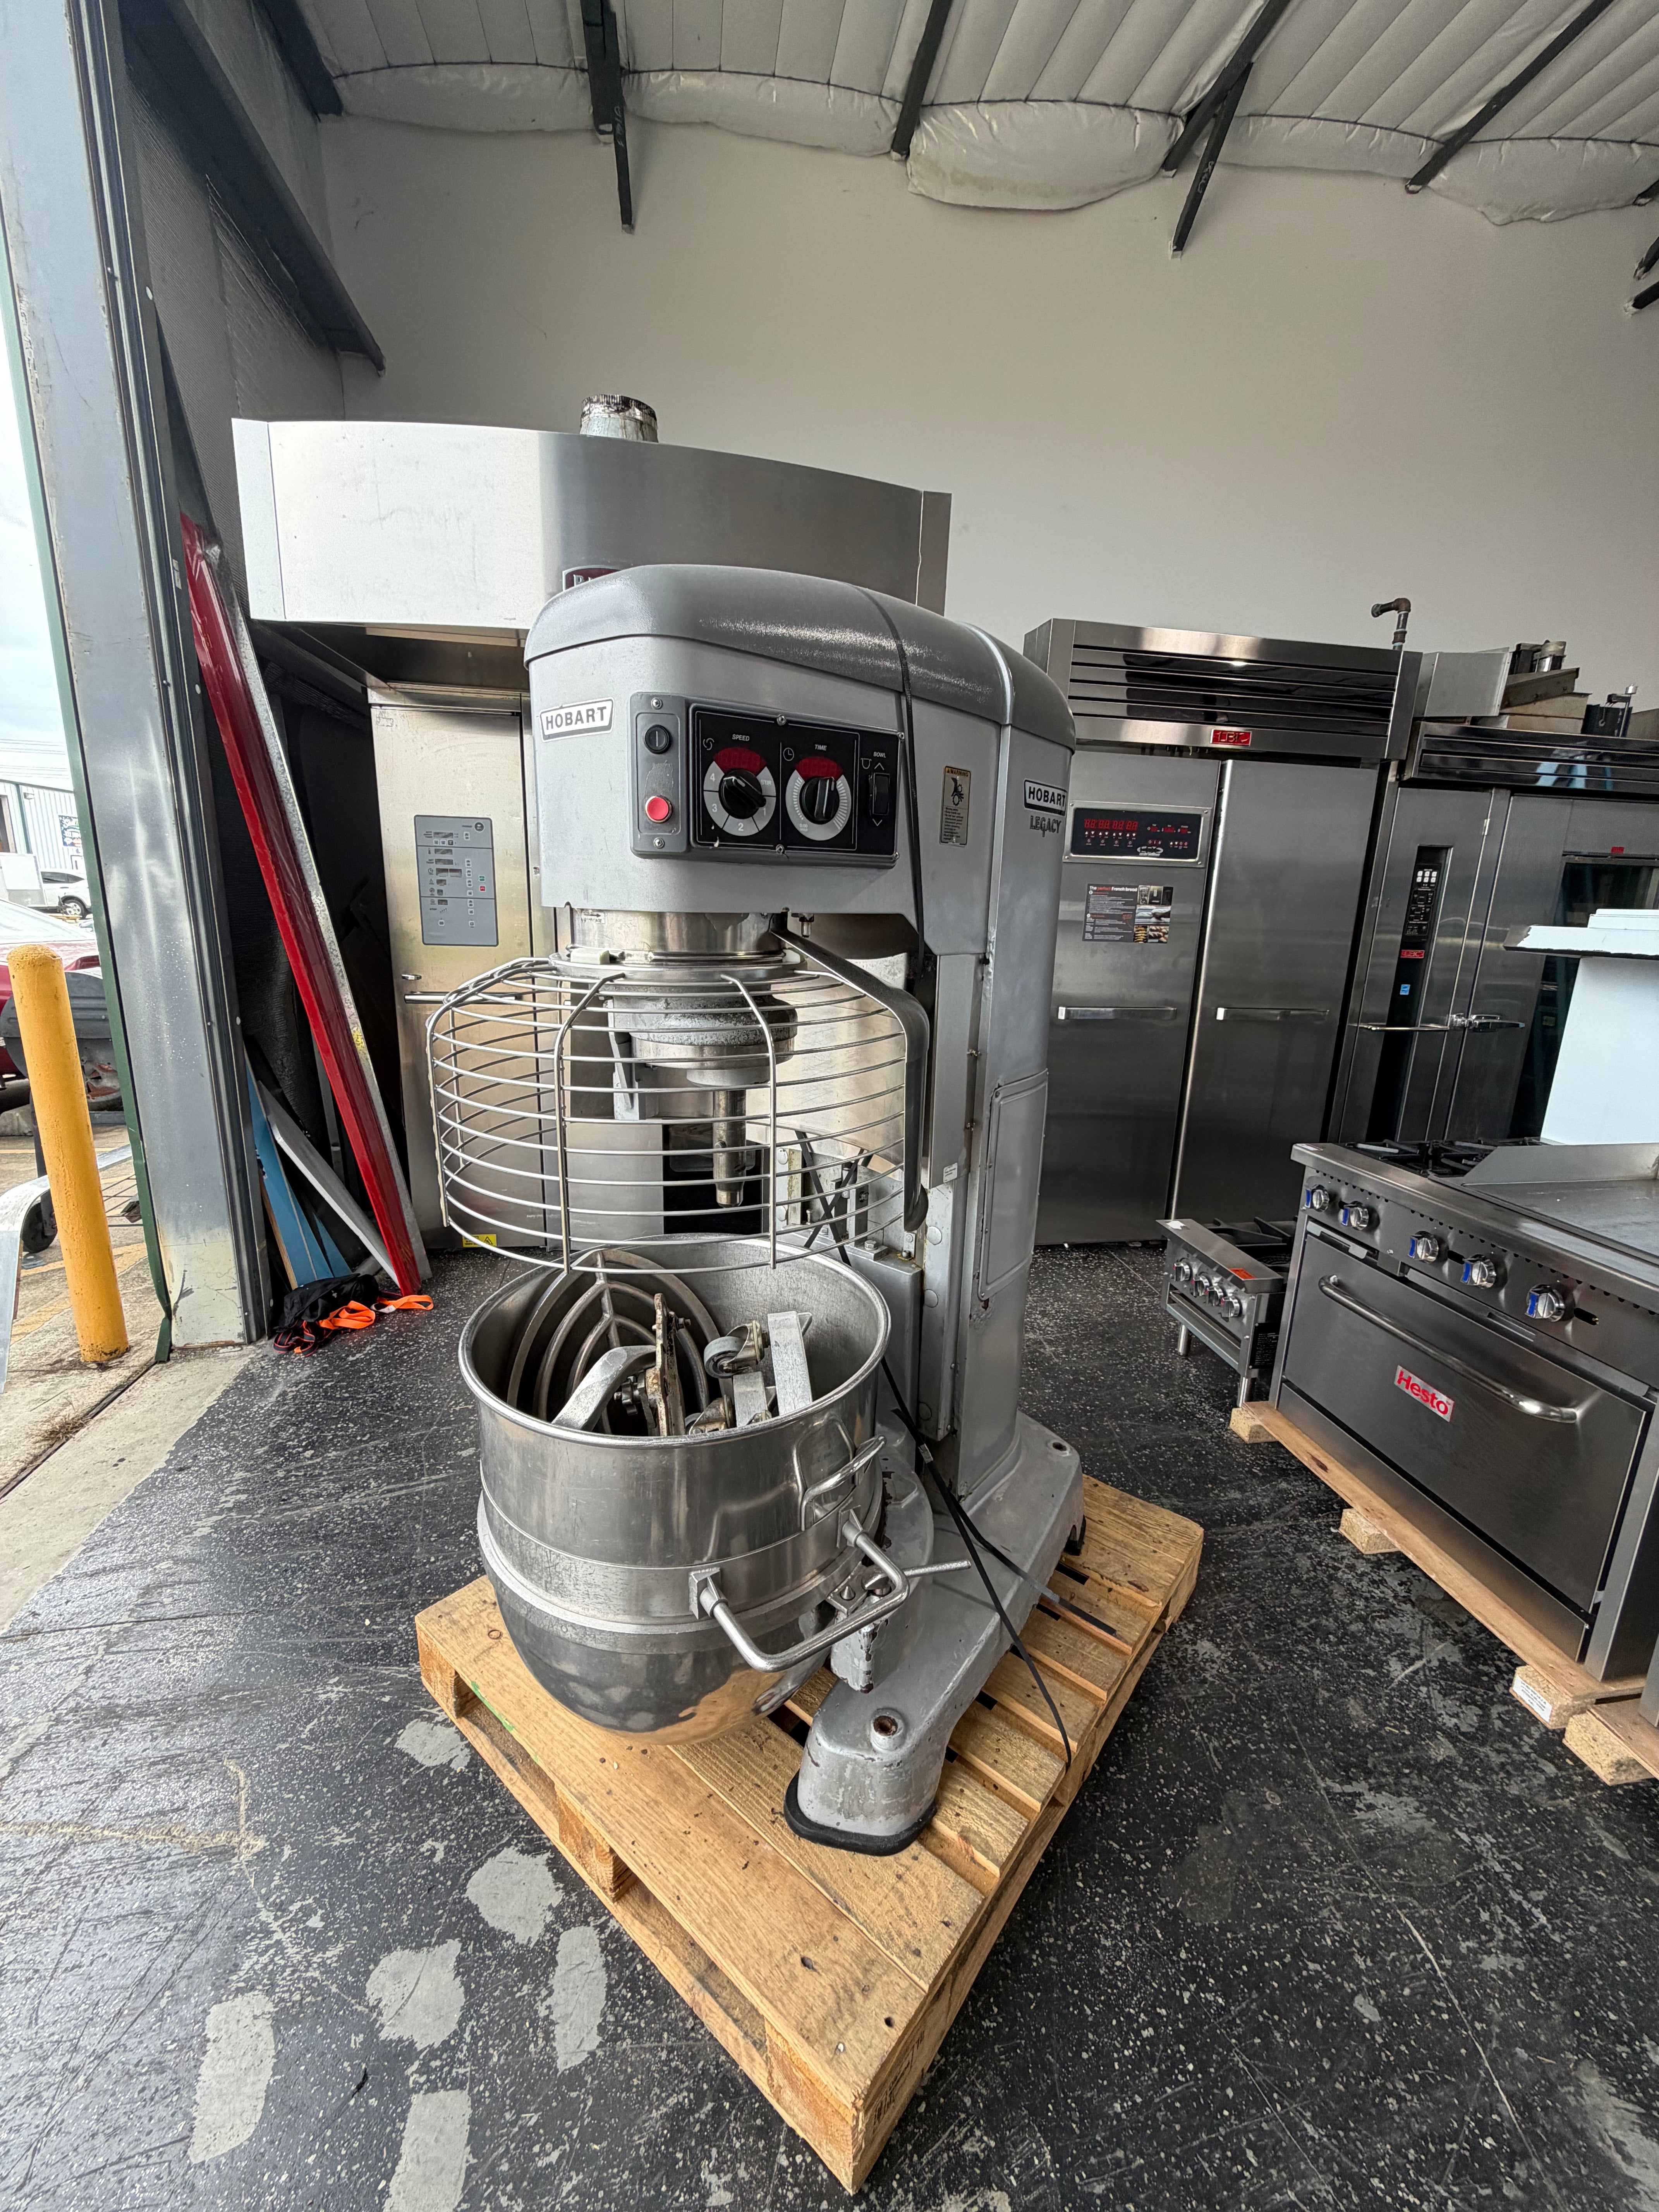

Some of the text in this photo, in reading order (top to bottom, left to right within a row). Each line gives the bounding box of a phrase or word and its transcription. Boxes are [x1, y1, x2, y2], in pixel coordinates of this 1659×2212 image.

[546, 706, 607, 730] HOBART
[710, 773, 715, 782] 4
[1029, 786, 1066, 807] HOBART
[712, 803, 717, 812] 3
[763, 807, 766, 816] 1
[738, 823, 744, 831] 2
[1030, 815, 1061, 837] LEGACY
[1397, 1370, 1448, 1415] Hesto
